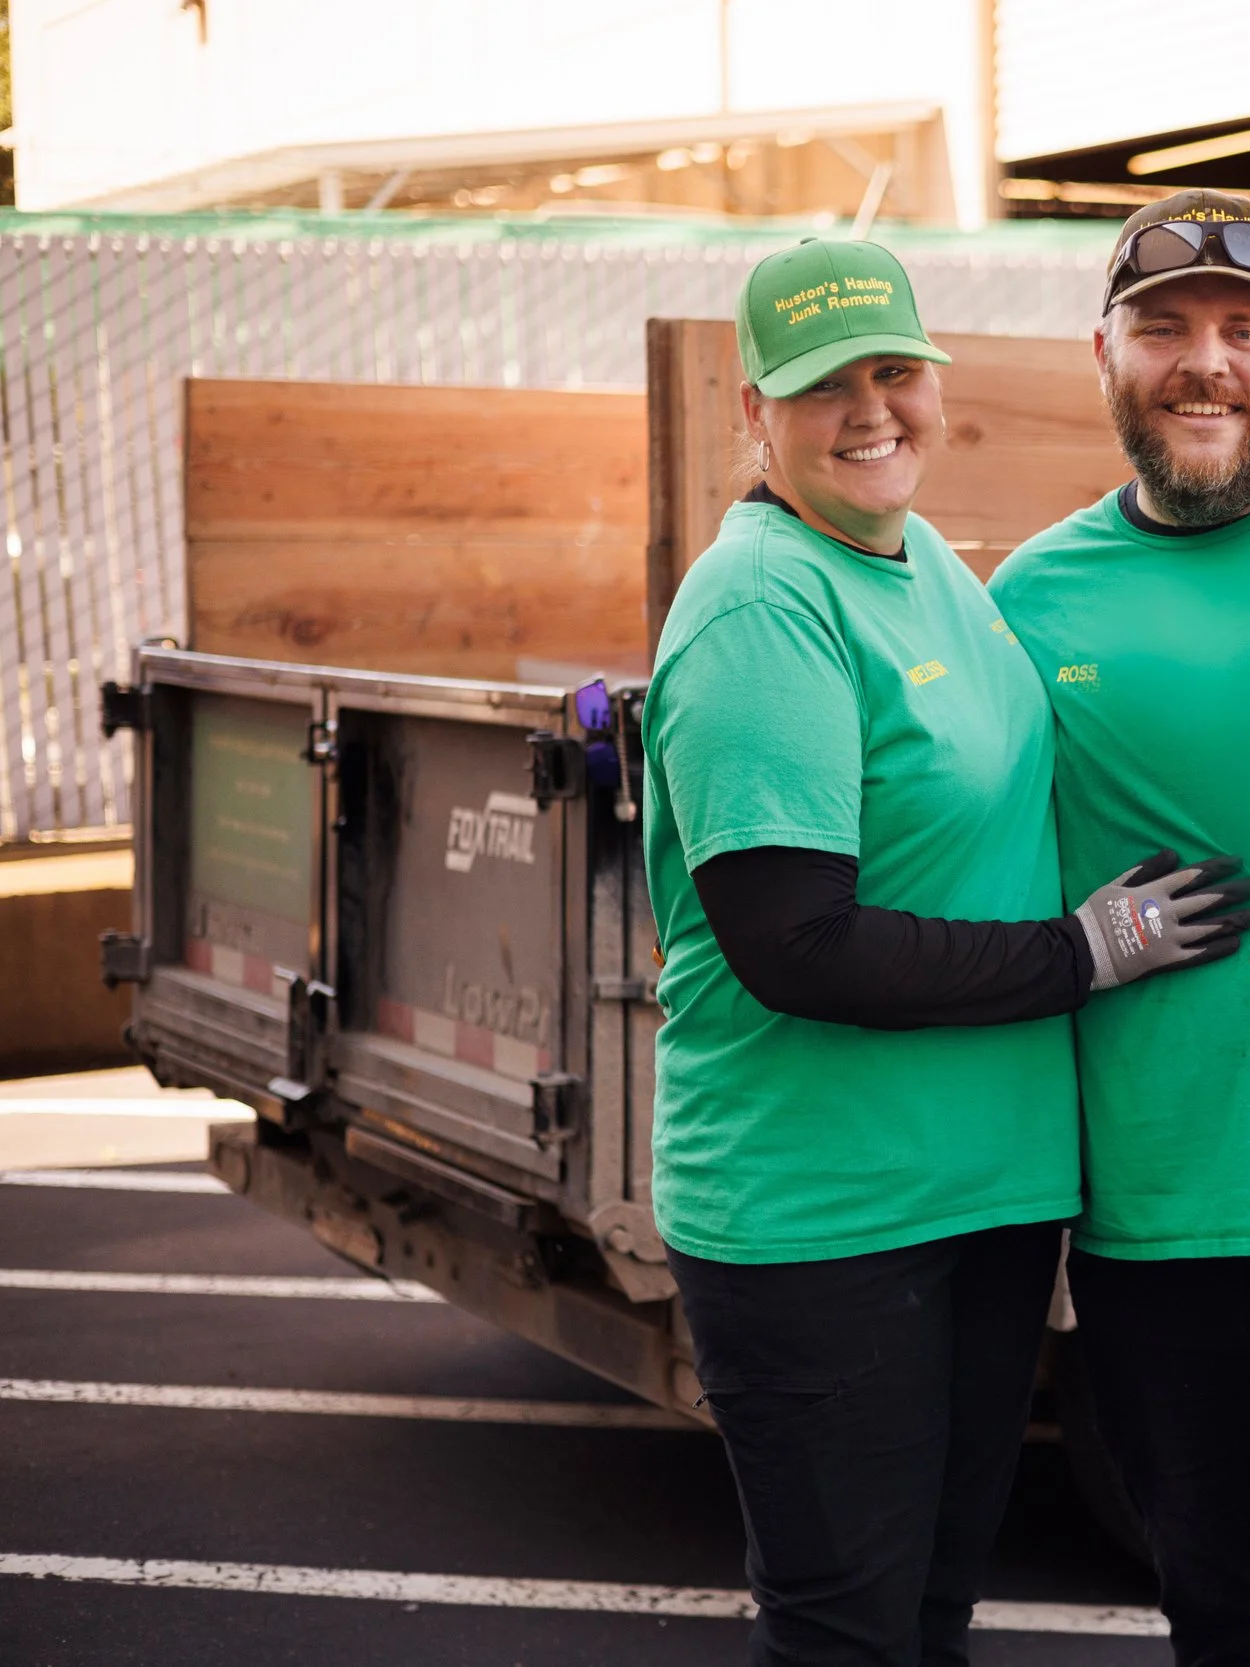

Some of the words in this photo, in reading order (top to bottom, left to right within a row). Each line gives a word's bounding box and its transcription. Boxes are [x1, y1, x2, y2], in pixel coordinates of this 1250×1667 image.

[775, 282, 839, 312] Huston's
[844, 277, 893, 293] Hauling
[788, 303, 821, 324] Junk
[827, 293, 890, 310] Removal
[1057, 664, 1098, 683] ROSS
